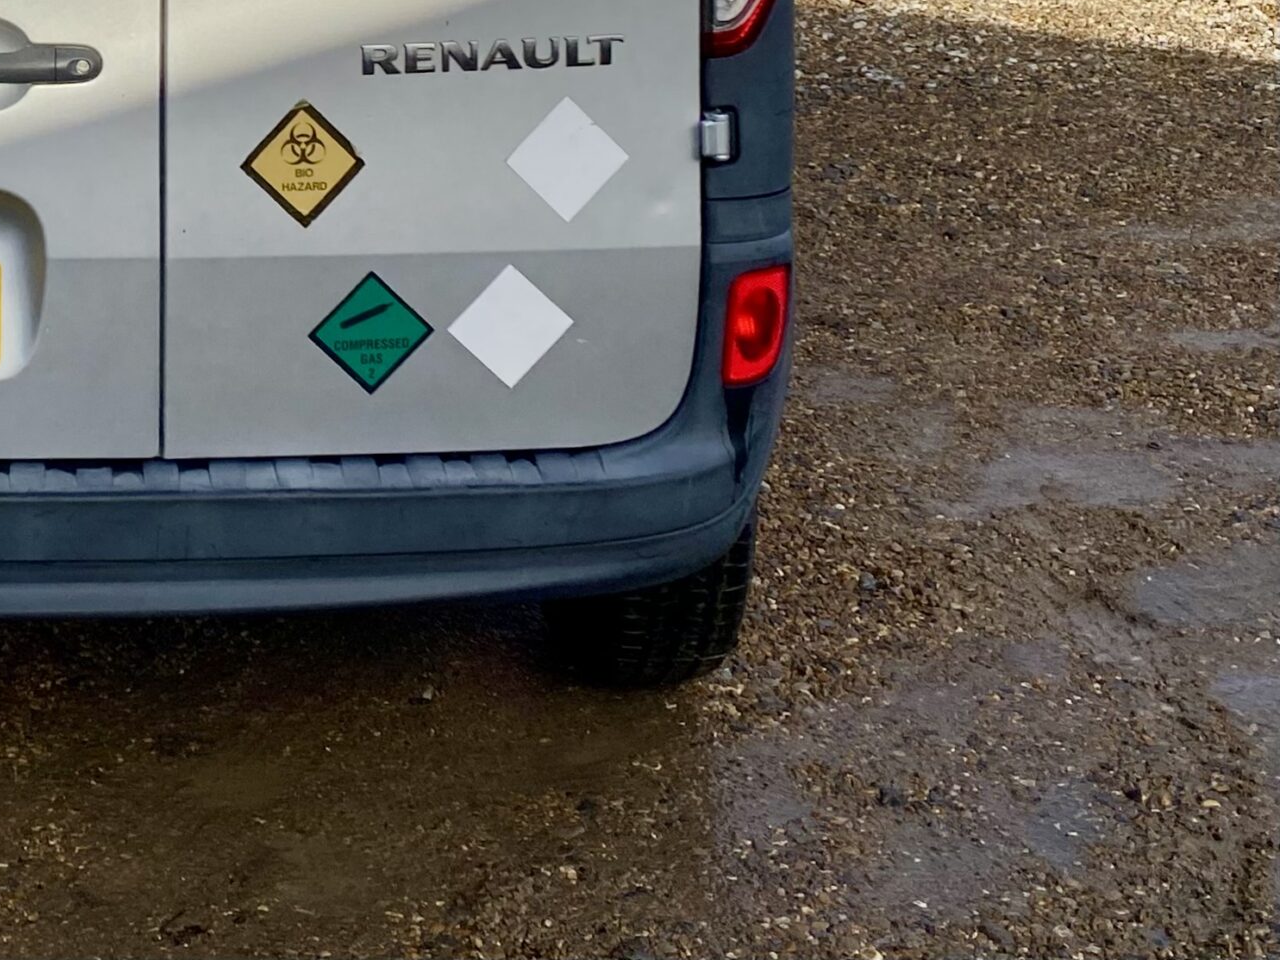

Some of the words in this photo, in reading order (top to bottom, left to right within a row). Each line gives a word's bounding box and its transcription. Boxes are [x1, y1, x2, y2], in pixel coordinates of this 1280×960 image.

[360, 34, 625, 76] RENAULT
[294, 167, 314, 178] BIO
[281, 180, 328, 192] HAZARD
[333, 337, 410, 352] COMPRESSED
[360, 352, 383, 365] GAS
[368, 367, 376, 379] 2
